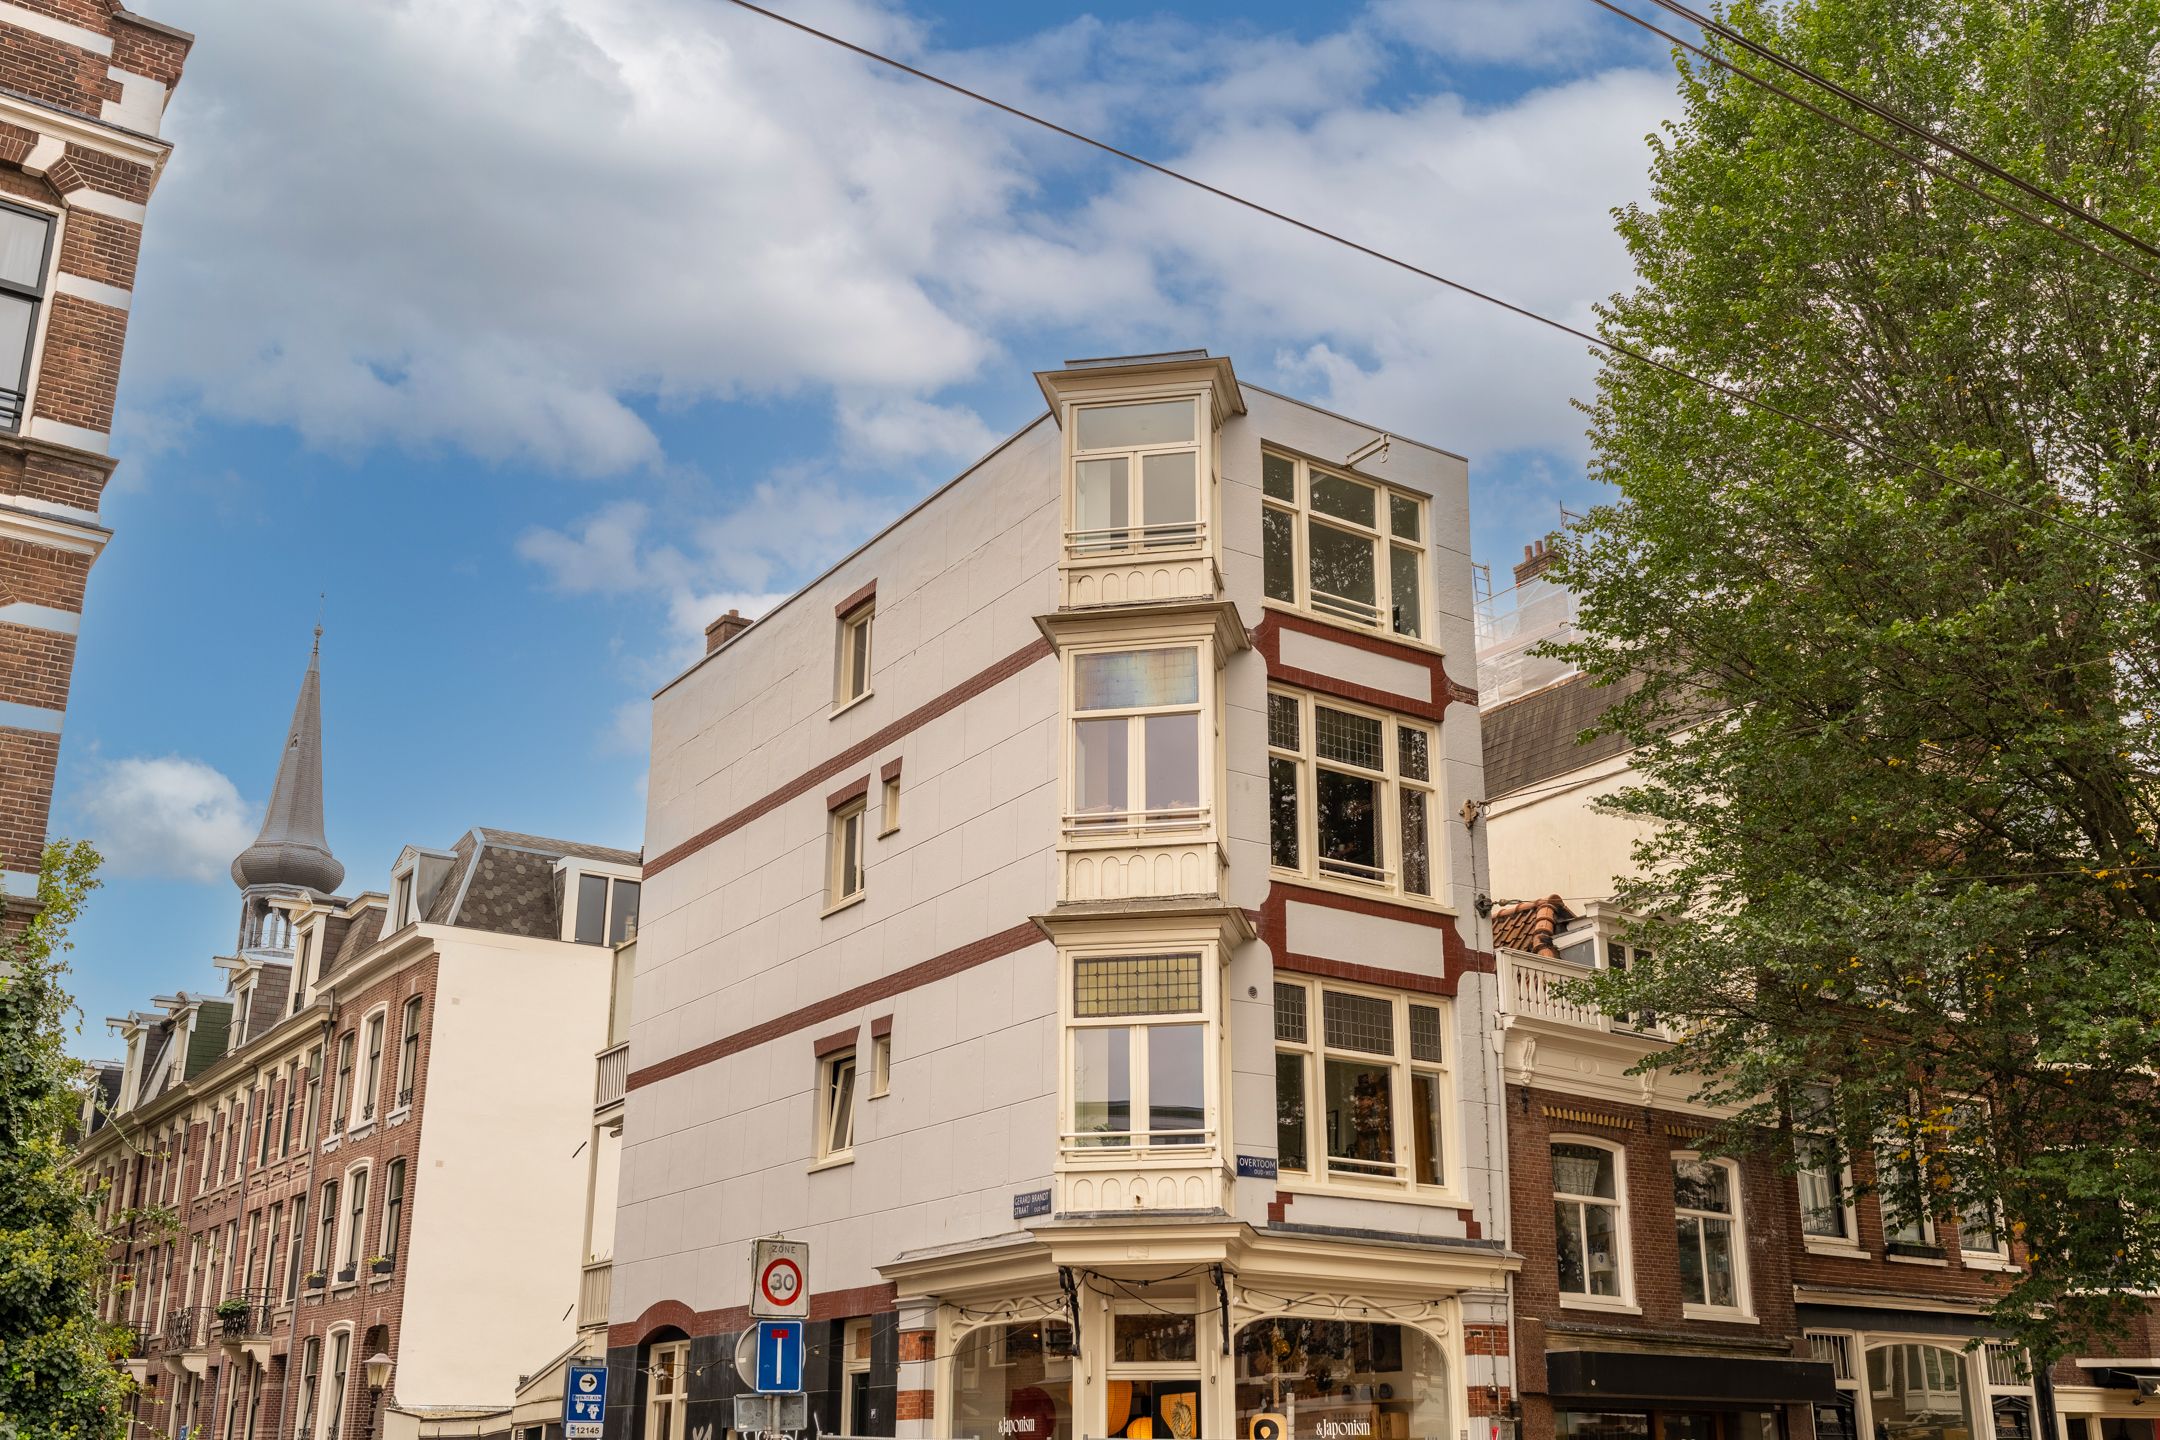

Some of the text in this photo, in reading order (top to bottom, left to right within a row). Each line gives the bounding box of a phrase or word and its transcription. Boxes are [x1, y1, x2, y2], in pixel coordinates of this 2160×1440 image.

[1239, 1157, 1276, 1169] OVERTOOM
[1015, 1191, 1049, 1206] GERARD BRANDT
[1014, 1205, 1029, 1216] STRAAT
[771, 1244, 796, 1254] ZONE
[770, 1272, 795, 1291] 30
[998, 1415, 1035, 1437] &Japonism
[1316, 1418, 1371, 1439] &Japonism
